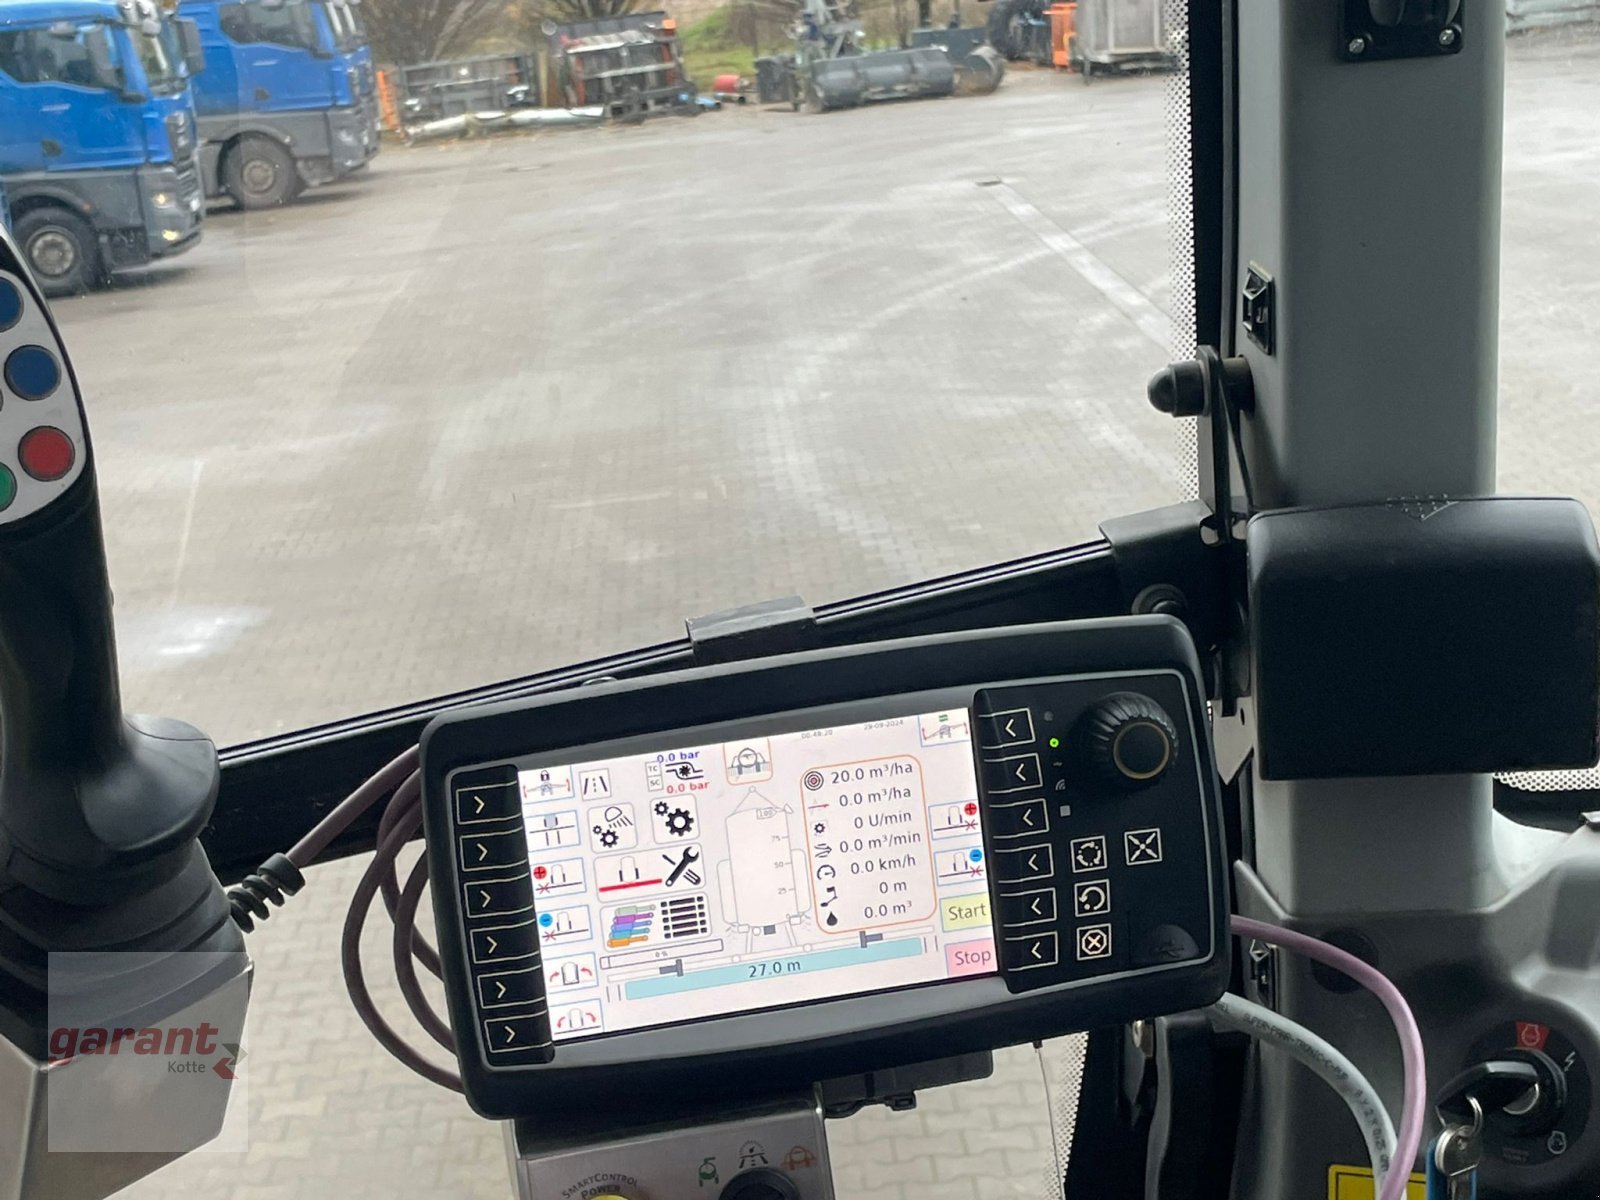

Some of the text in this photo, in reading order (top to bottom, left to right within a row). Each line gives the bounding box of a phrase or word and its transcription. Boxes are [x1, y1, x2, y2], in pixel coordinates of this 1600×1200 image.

[656, 751, 700, 764] 0.0 bar
[831, 762, 913, 785] 20.0 m³/ha
[650, 779, 661, 787] SC
[666, 781, 710, 794] 0.0 bar
[839, 787, 912, 807] 0.0 m³/ha
[854, 811, 912, 829] 0 U/min
[839, 831, 921, 853] 0.0 m³/min
[774, 861, 784, 869] 50
[850, 854, 916, 875] 0.0 km/h
[879, 881, 907, 894] 0 m
[864, 900, 913, 919] 0.0 m³
[948, 903, 986, 921] Start
[955, 949, 991, 966] Stop
[749, 960, 801, 978] 27.0 m
